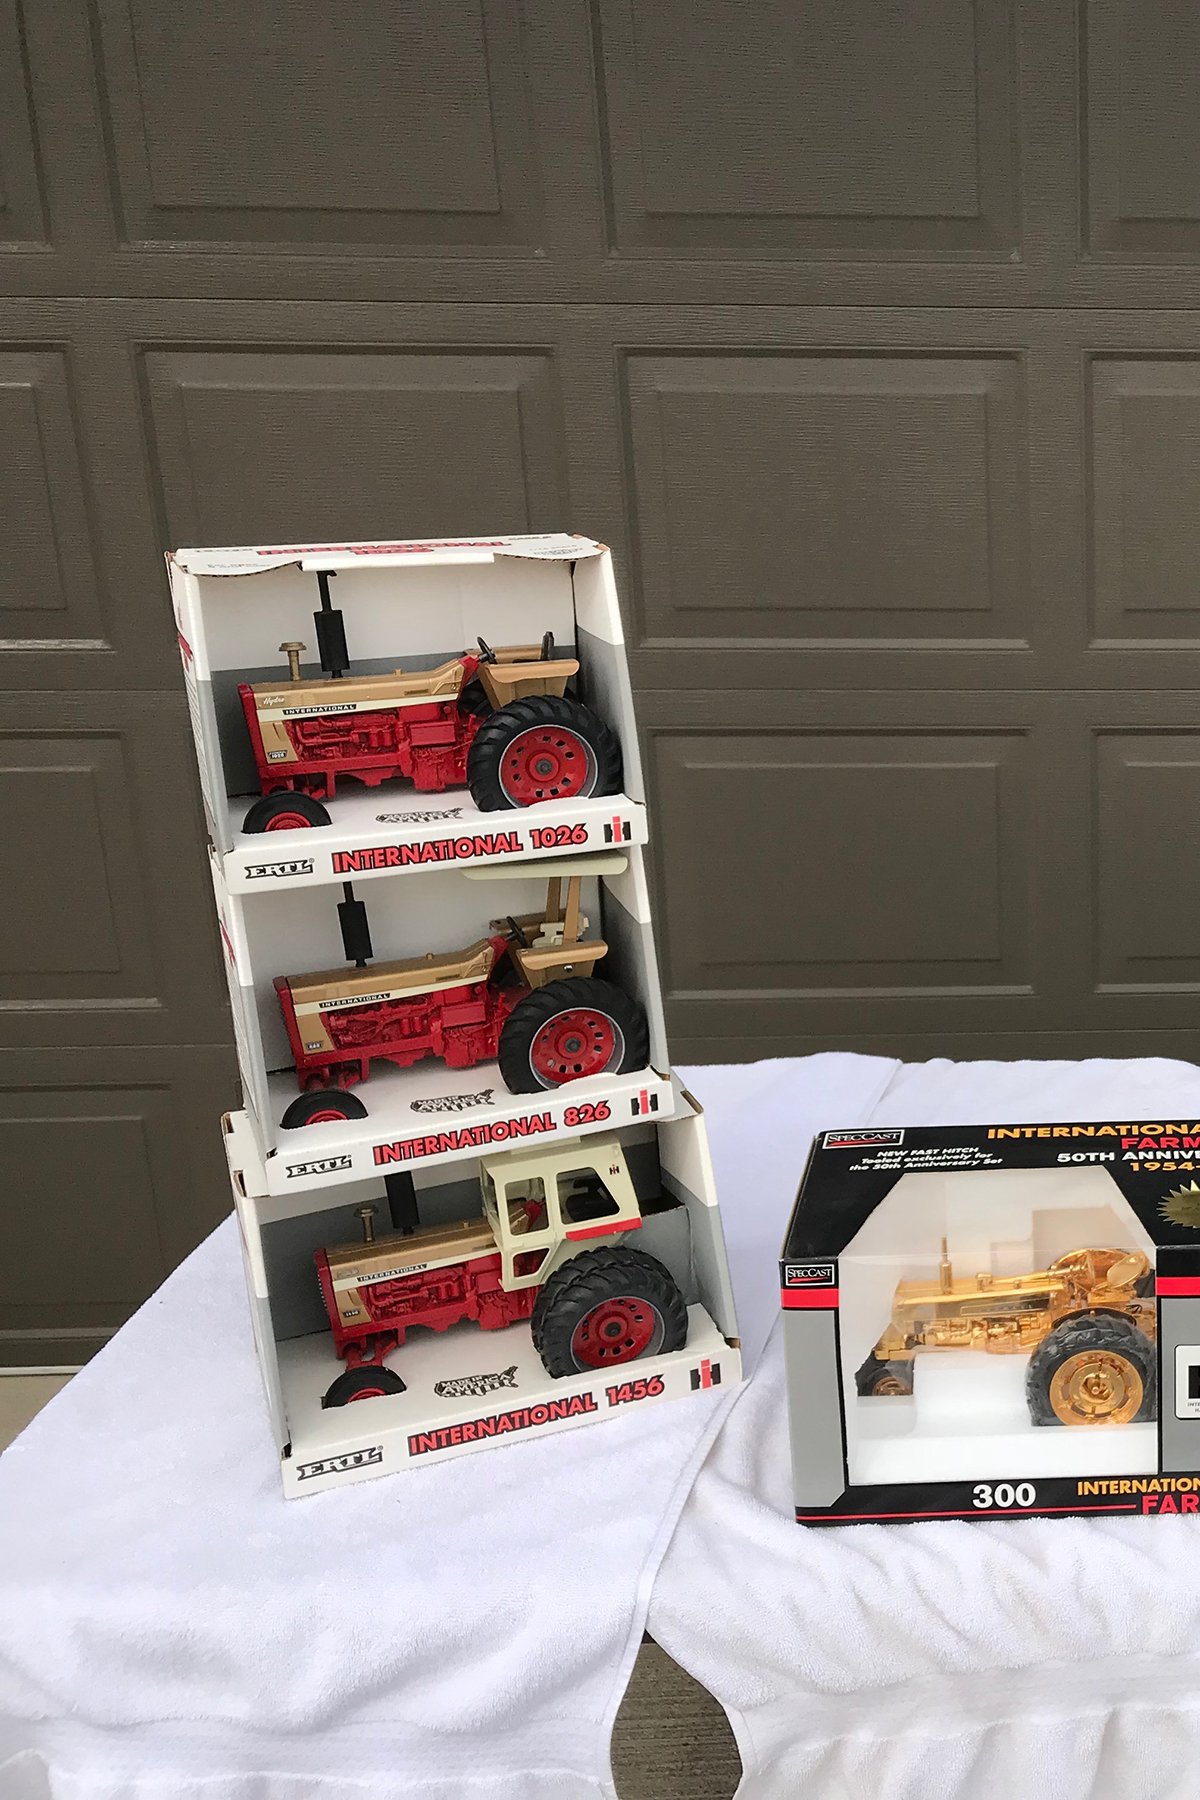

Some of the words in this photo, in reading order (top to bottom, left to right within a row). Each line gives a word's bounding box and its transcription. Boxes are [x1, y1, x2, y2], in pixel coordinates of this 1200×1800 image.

[285, 705, 354, 715] INTERNATIONAL
[331, 832, 523, 874] INTERNATIONAL
[529, 823, 588, 849] 1026
[321, 994, 387, 1007] INTERNATIONAL
[373, 1113, 557, 1166] INTERNATIONAL
[563, 1101, 611, 1128] 826
[904, 1153, 971, 1162] exclusively
[904, 1159, 980, 1168] Anniversary
[983, 1157, 1003, 1165] Set
[1057, 1152, 1115, 1163] 50TH
[360, 1265, 427, 1281] INTERNATIONAL
[408, 1395, 598, 1456] INTERNATIONAL
[607, 1375, 664, 1406] 1456
[972, 1483, 1036, 1508] 300
